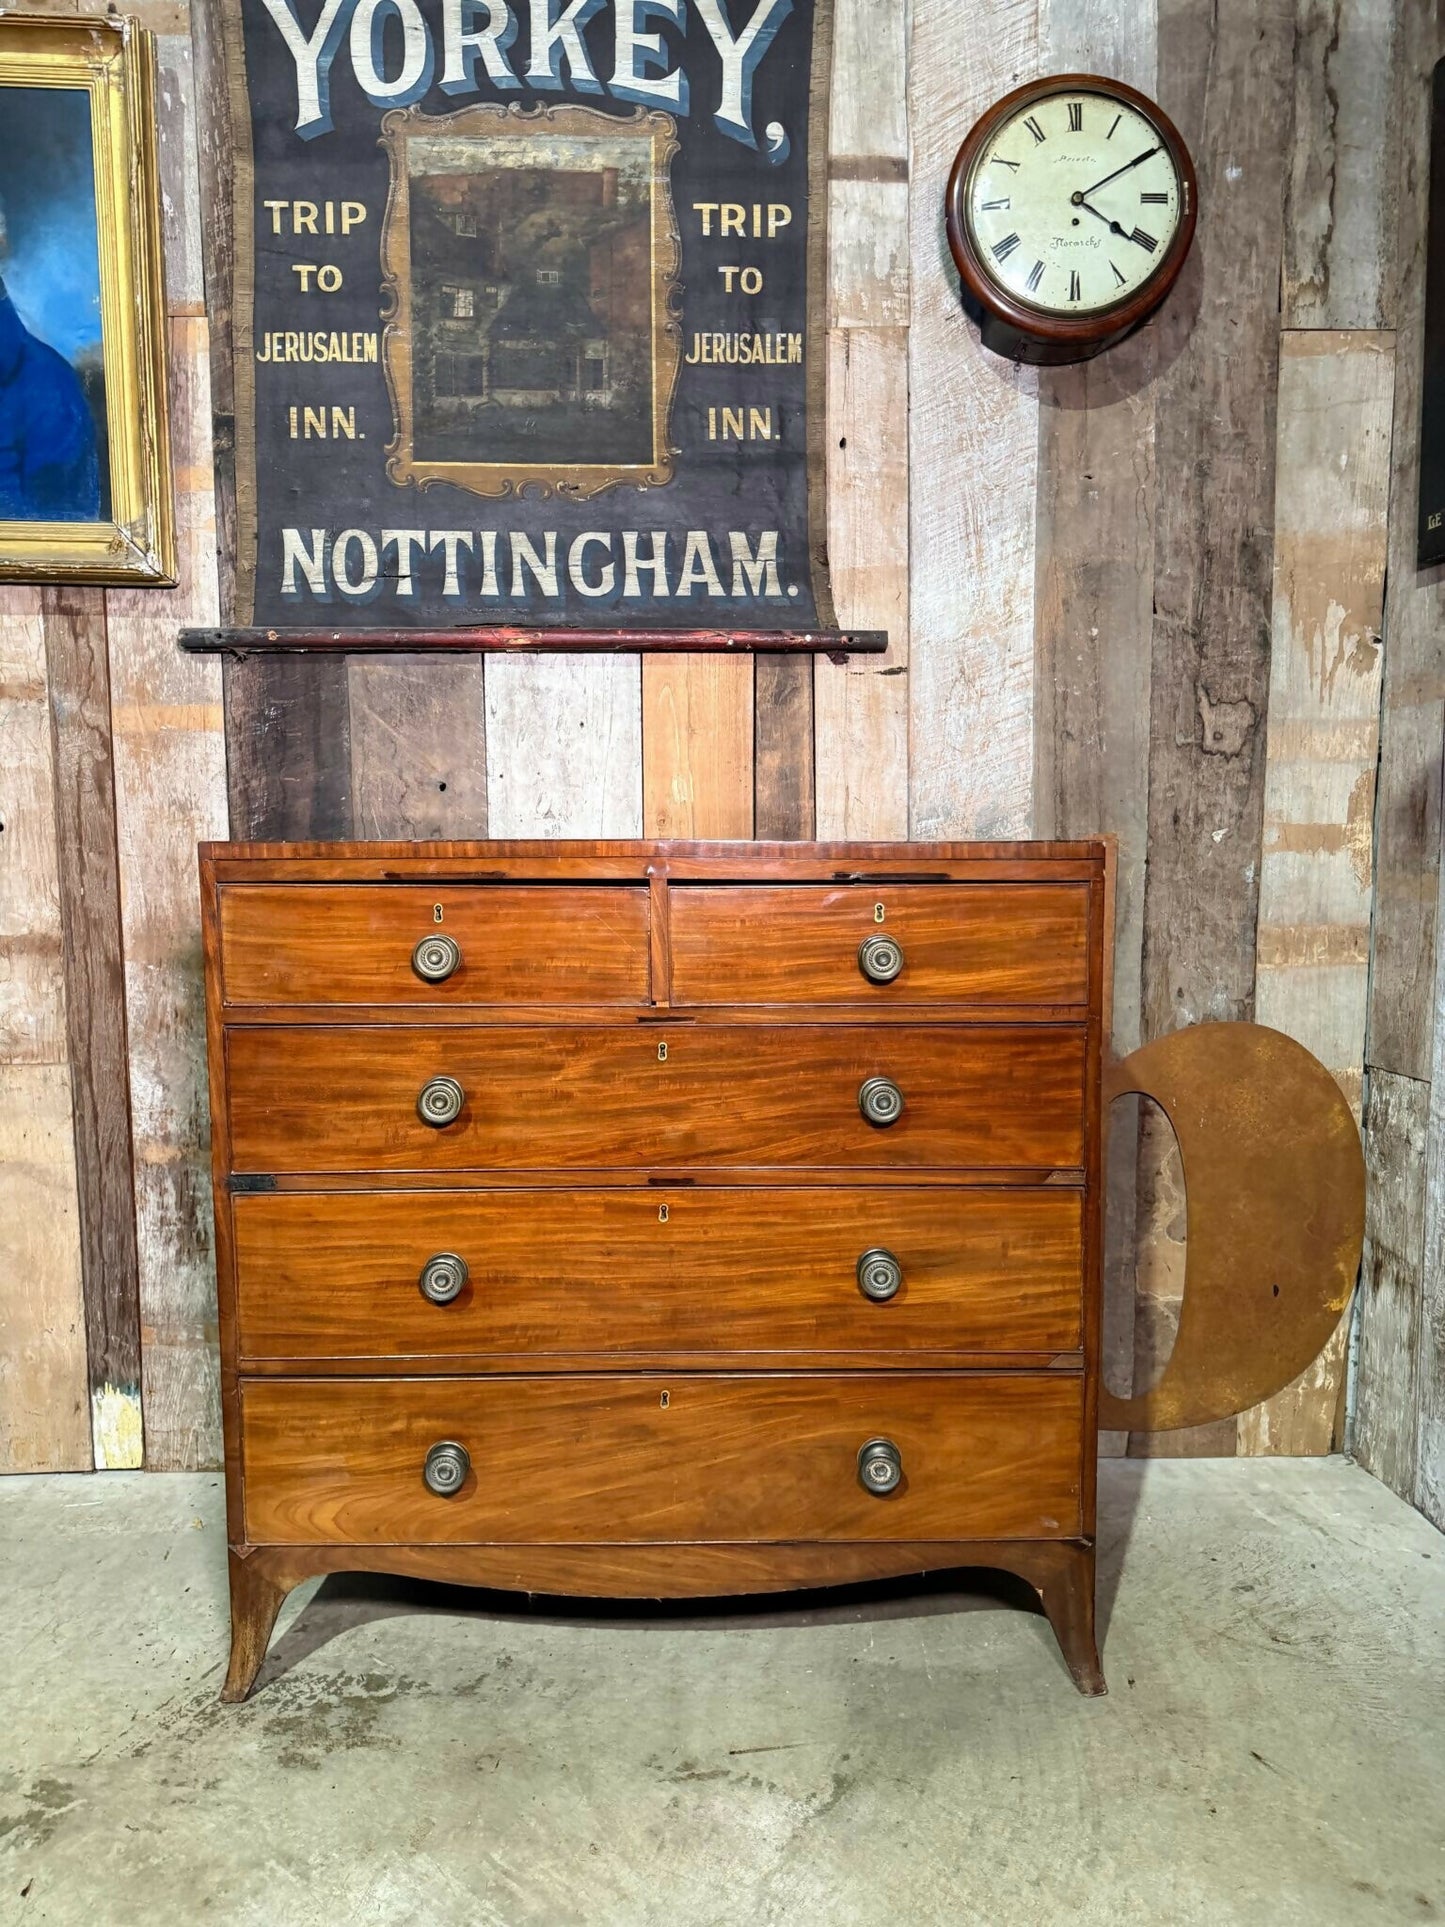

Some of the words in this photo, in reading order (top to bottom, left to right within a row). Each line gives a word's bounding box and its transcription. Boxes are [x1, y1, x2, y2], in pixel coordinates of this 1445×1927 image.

[262, 0, 787, 153] YORKEY,
[1065, 102, 1083, 133] XII
[1139, 190, 1169, 206] III
[263, 200, 367, 235] TRIP
[692, 202, 792, 238] TRIP
[291, 264, 343, 293] TO
[718, 265, 763, 295] TO
[256, 331, 378, 363] JERUSALEM
[685, 332, 802, 365] JERUSALEM
[289, 406, 366, 440] INN.
[708, 406, 781, 441] INN.
[280, 528, 799, 598] NOTTINGHAM.
